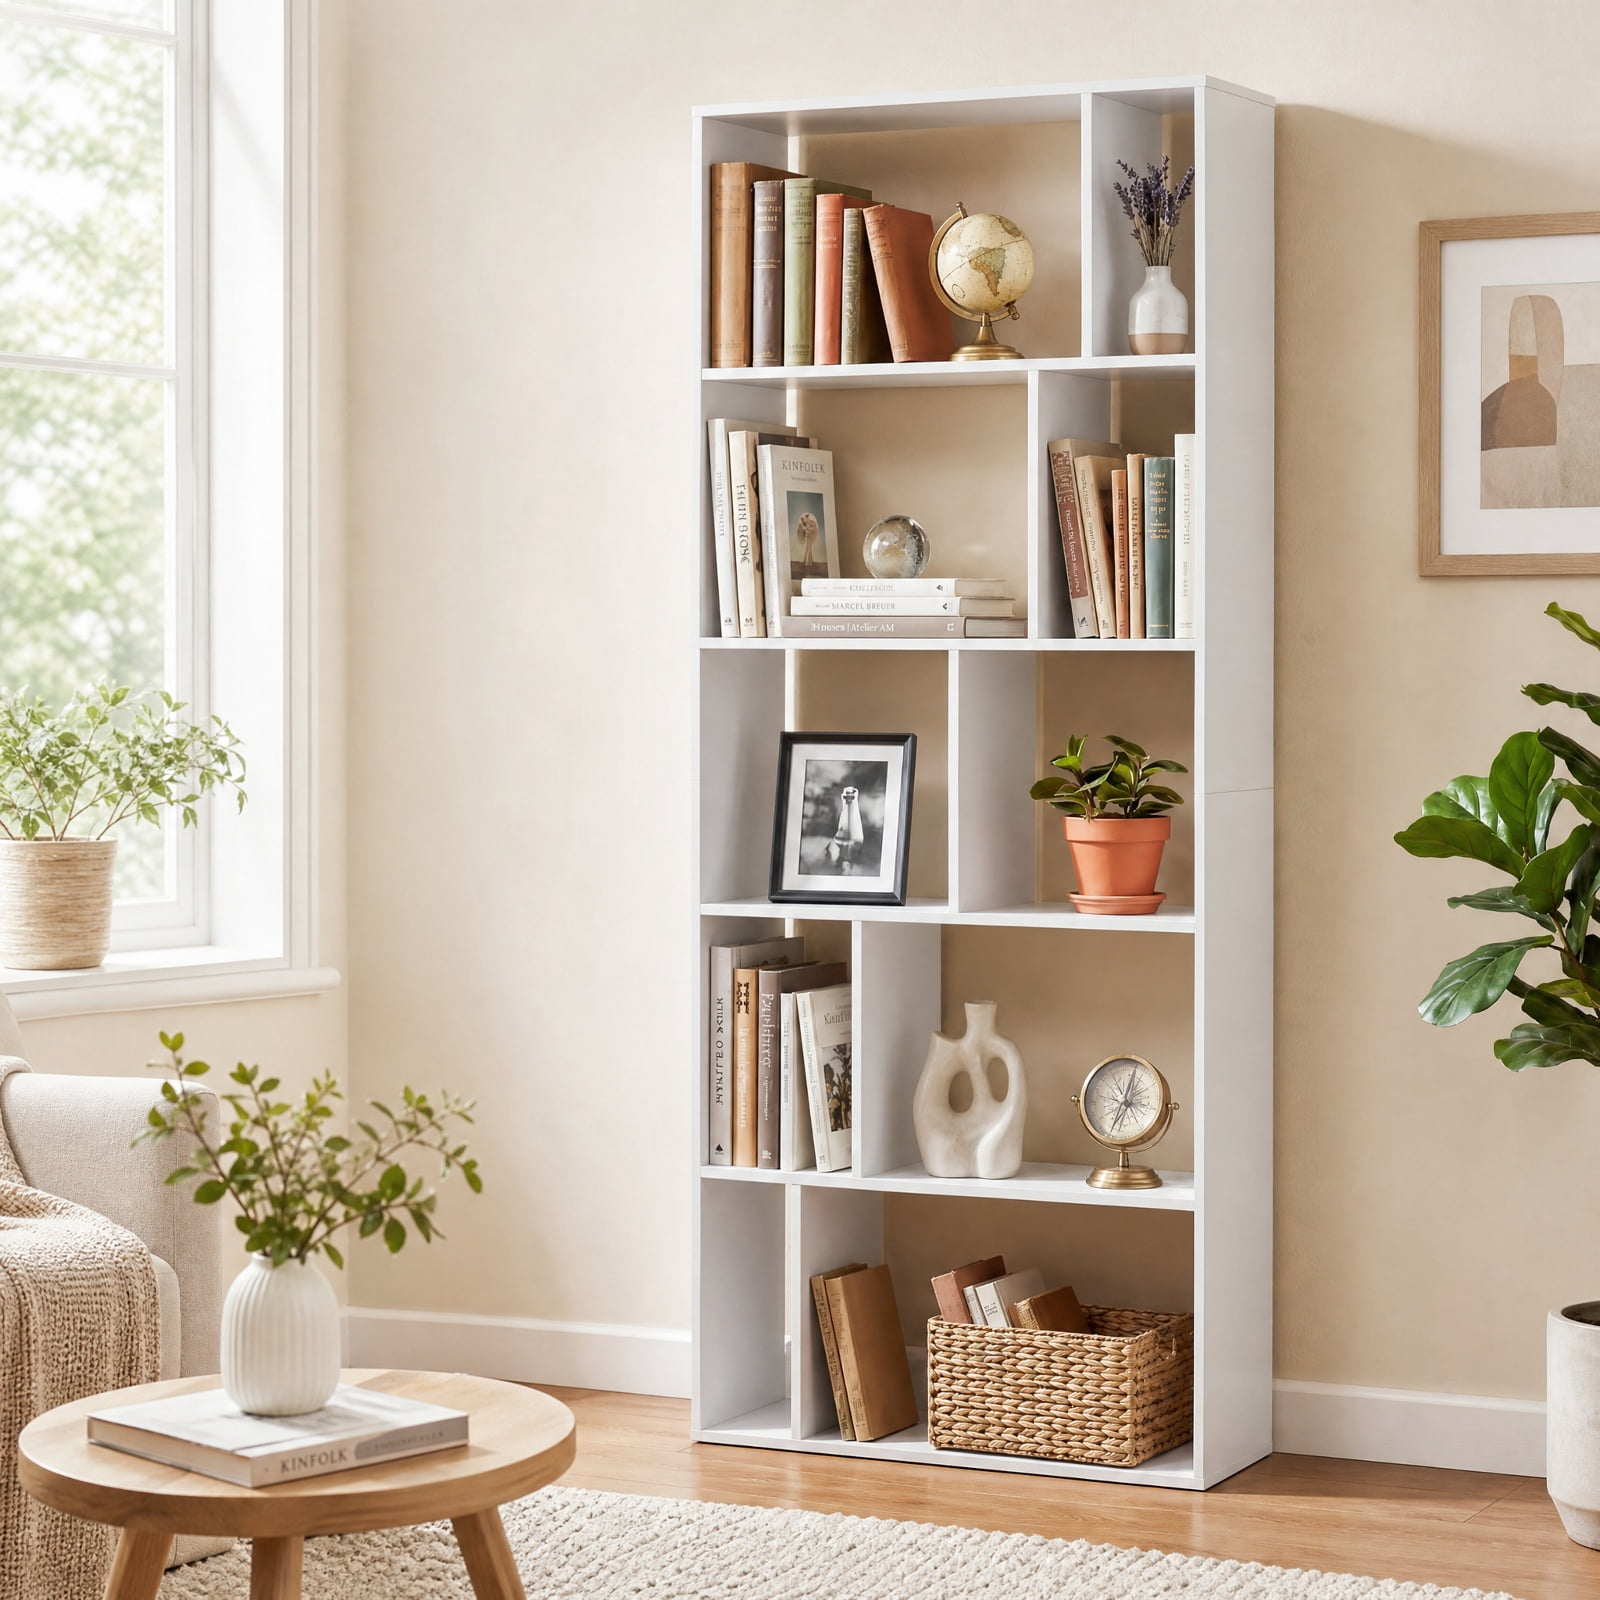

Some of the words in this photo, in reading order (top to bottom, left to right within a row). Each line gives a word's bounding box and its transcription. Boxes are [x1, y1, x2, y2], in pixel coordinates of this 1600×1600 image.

[831, 602, 865, 610] MARCEL
[866, 602, 896, 610] BREUER
[811, 623, 845, 632] Houses
[851, 622, 878, 632] Atelier
[880, 623, 895, 632] AM
[280, 1448, 349, 1473] KINFOLK
